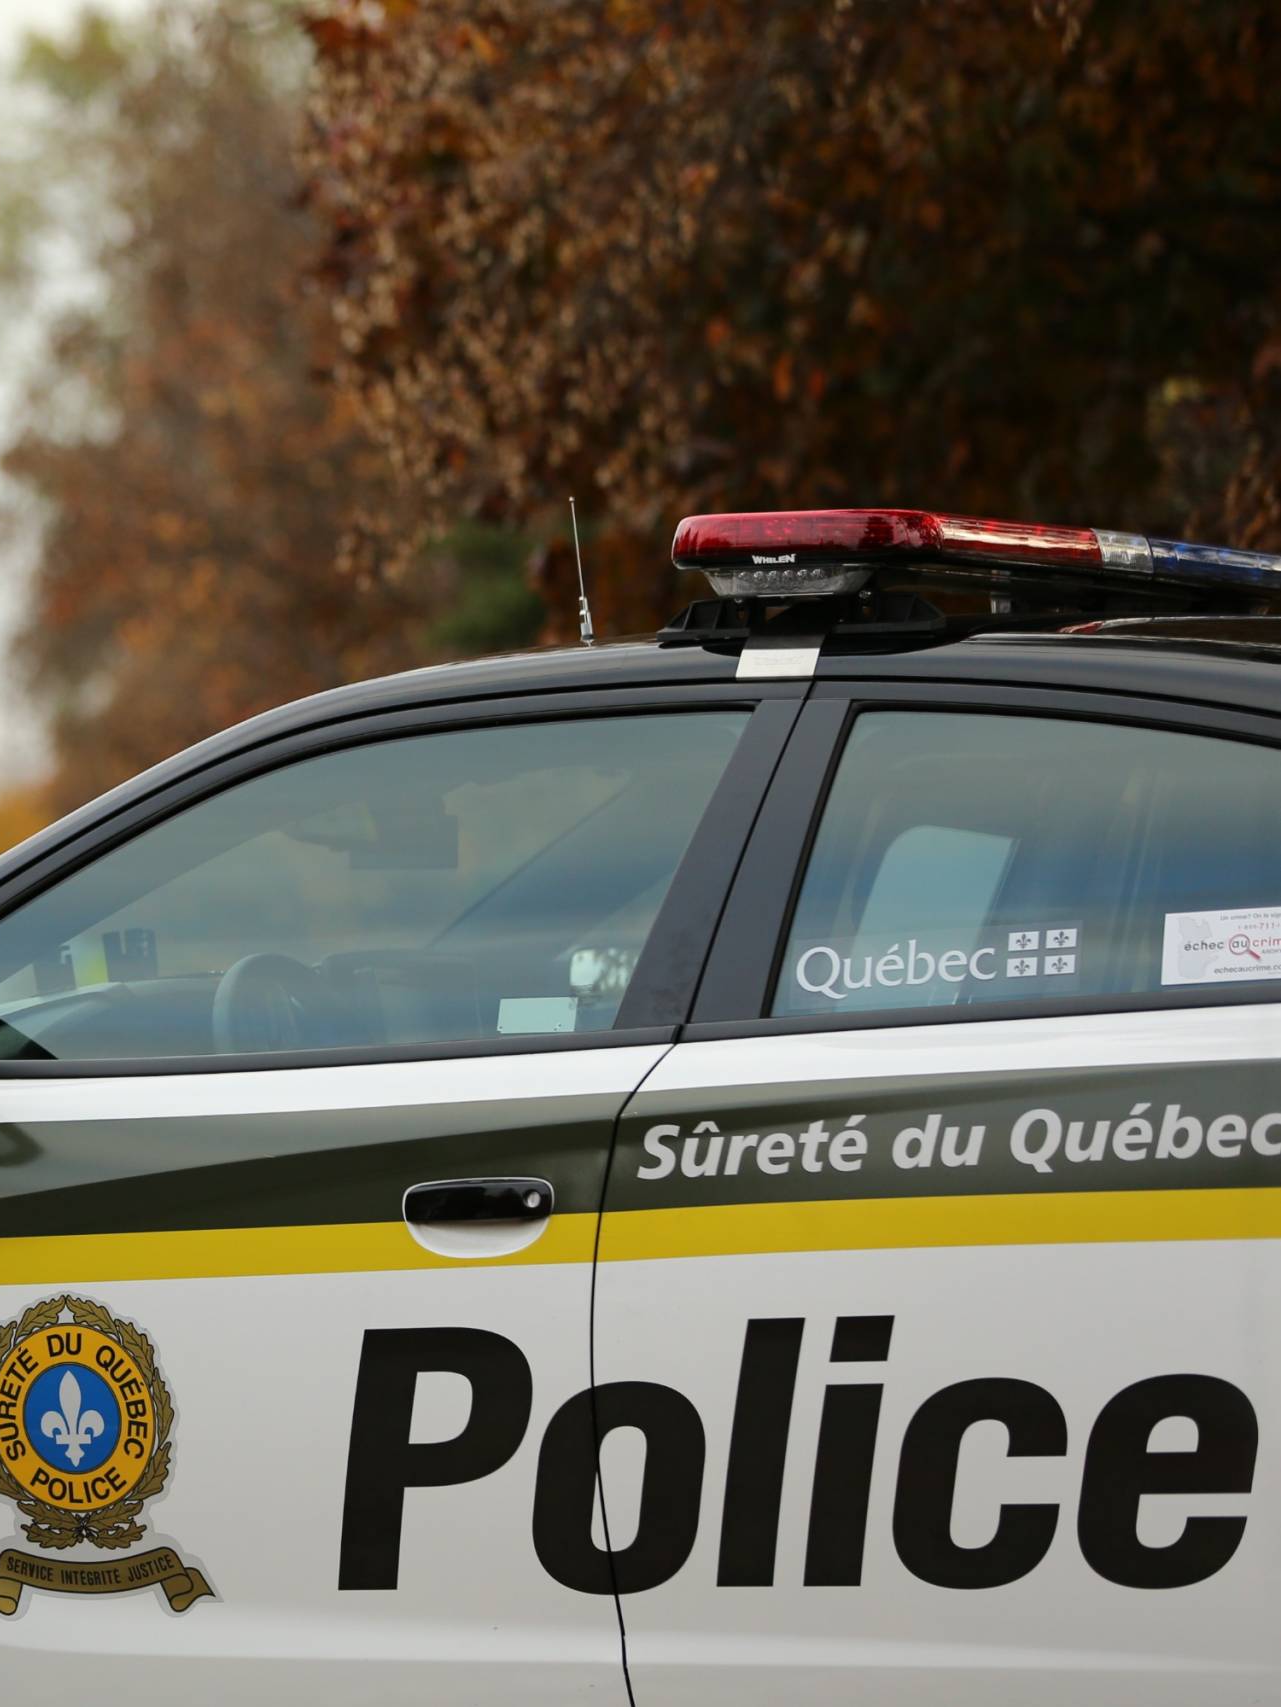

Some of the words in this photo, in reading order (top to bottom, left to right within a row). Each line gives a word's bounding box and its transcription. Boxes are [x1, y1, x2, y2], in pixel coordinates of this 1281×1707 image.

[796, 939, 998, 999] Québec
[1232, 940, 1248, 949] au
[636, 1114, 868, 1180] Sûreté
[892, 1114, 986, 1169] du
[1009, 1102, 1281, 1173] Québec
[46, 1332, 82, 1357] DU
[95, 1345, 148, 1459] QUÉBEC
[30, 1466, 127, 1503] POLICE
[338, 1314, 1259, 1595] Police
[6, 1556, 54, 1581] SERVICE
[128, 1554, 175, 1583] JUSTICE
